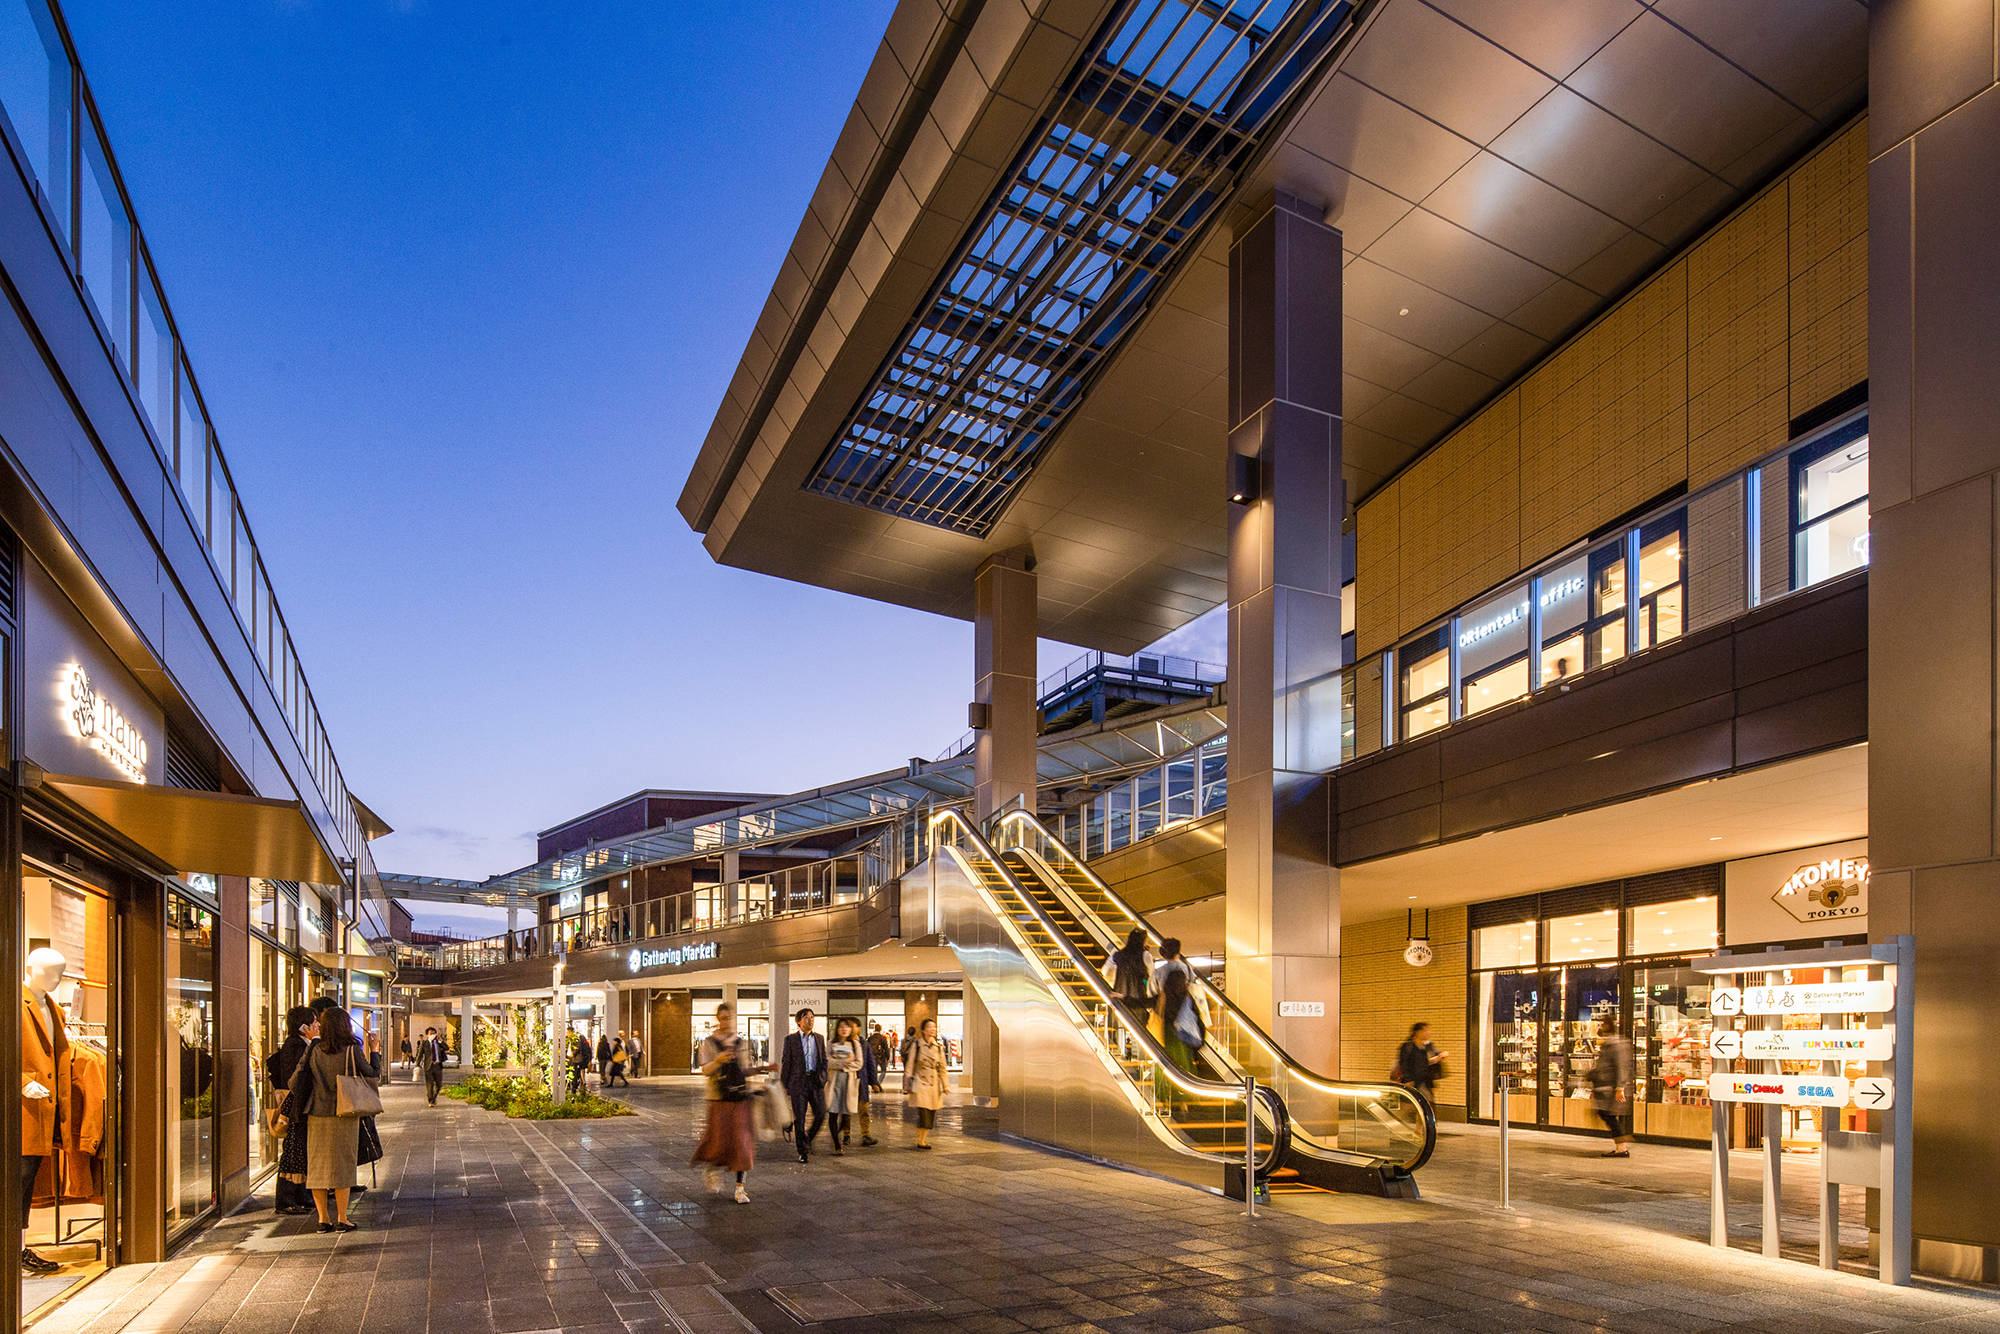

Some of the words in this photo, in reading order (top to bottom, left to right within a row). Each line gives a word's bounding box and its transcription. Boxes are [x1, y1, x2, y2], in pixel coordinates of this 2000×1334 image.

[1522, 577, 1584, 615] Taffic
[102, 698, 147, 766] nano
[1808, 906, 1859, 919] TOKYO
[642, 947, 681, 967] Gathering
[682, 941, 718, 961] Market
[1803, 1040, 1821, 1049] FUN
[1823, 1040, 1865, 1049] VILLAGE
[1797, 1085, 1835, 1098] SEGA
